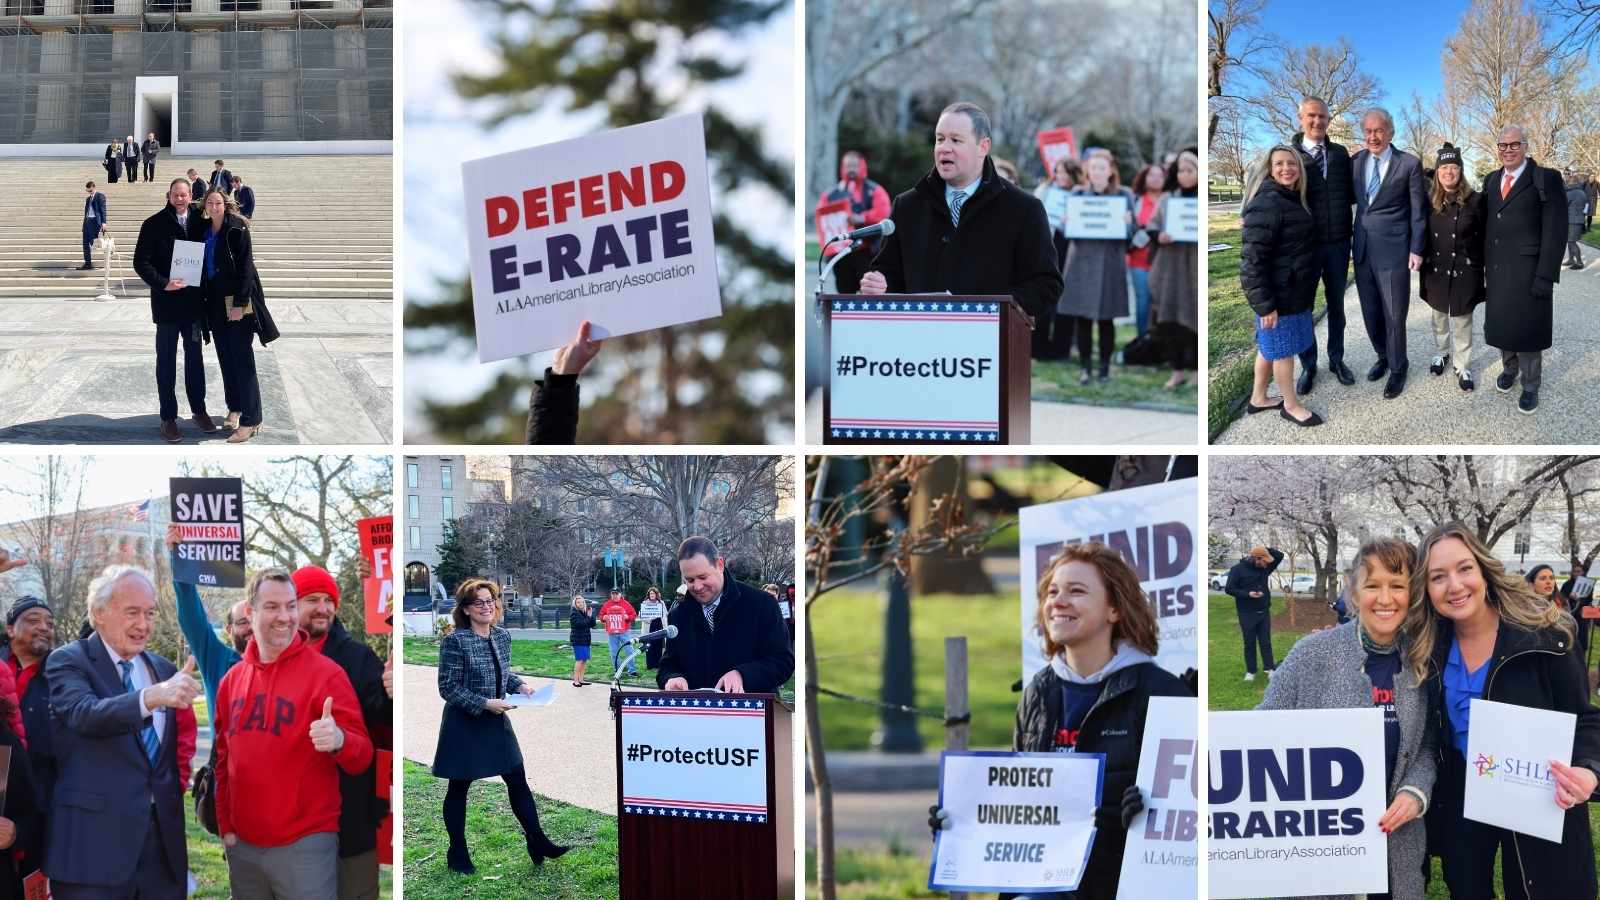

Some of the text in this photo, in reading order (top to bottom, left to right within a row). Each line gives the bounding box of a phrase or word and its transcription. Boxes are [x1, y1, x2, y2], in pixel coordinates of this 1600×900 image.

[485, 160, 686, 238] DEFEND
[490, 208, 692, 294] E-RATE
[837, 355, 992, 378] #ProtectUSF
[175, 493, 238, 520] SAVE
[177, 526, 240, 539] UNIVERSAL
[371, 535, 393, 545] BRO
[178, 544, 241, 561] SERVICE
[373, 547, 393, 579] F
[228, 691, 297, 737] GAP
[627, 744, 760, 767] #ProtectUSF
[988, 766, 1053, 787] PROTECT
[1208, 747, 1365, 804] UND
[977, 804, 1061, 825] UNIVERSAL
[1144, 808, 1198, 842] LIB
[984, 842, 1045, 862] SERVICE
